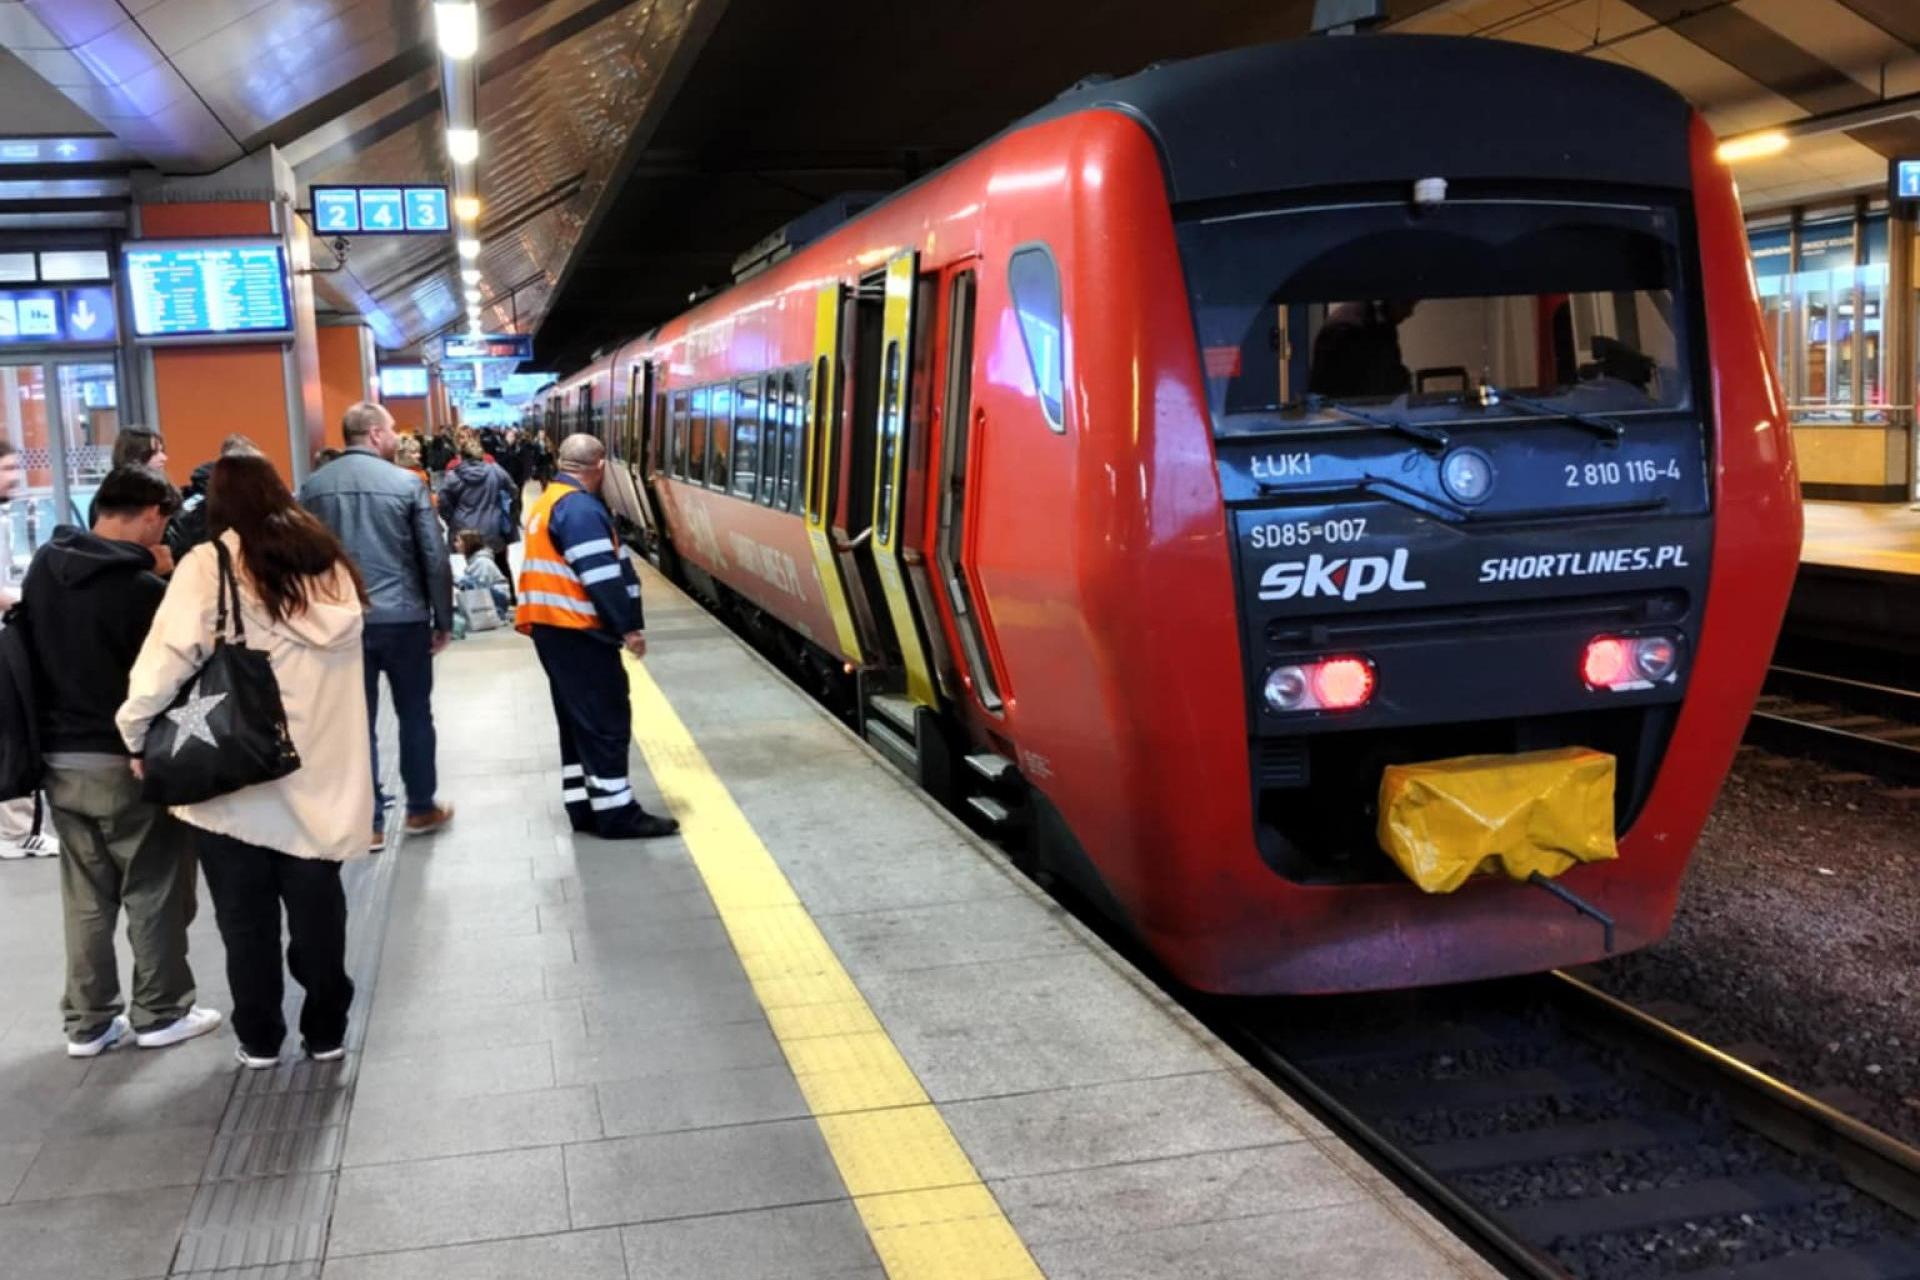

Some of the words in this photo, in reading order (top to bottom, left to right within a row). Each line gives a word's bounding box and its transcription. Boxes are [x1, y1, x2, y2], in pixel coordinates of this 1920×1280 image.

[328, 204, 348, 228] 2
[373, 203, 394, 228] 4
[417, 203, 437, 227] 3
[1251, 452, 1312, 479] ŁUKI
[1564, 464, 1580, 487] 2
[1584, 462, 1621, 486] 810
[1626, 458, 1681, 484] 116-4
[1251, 517, 1367, 549] SD85-007
[1478, 545, 1689, 583] SHORTLINES.PL
